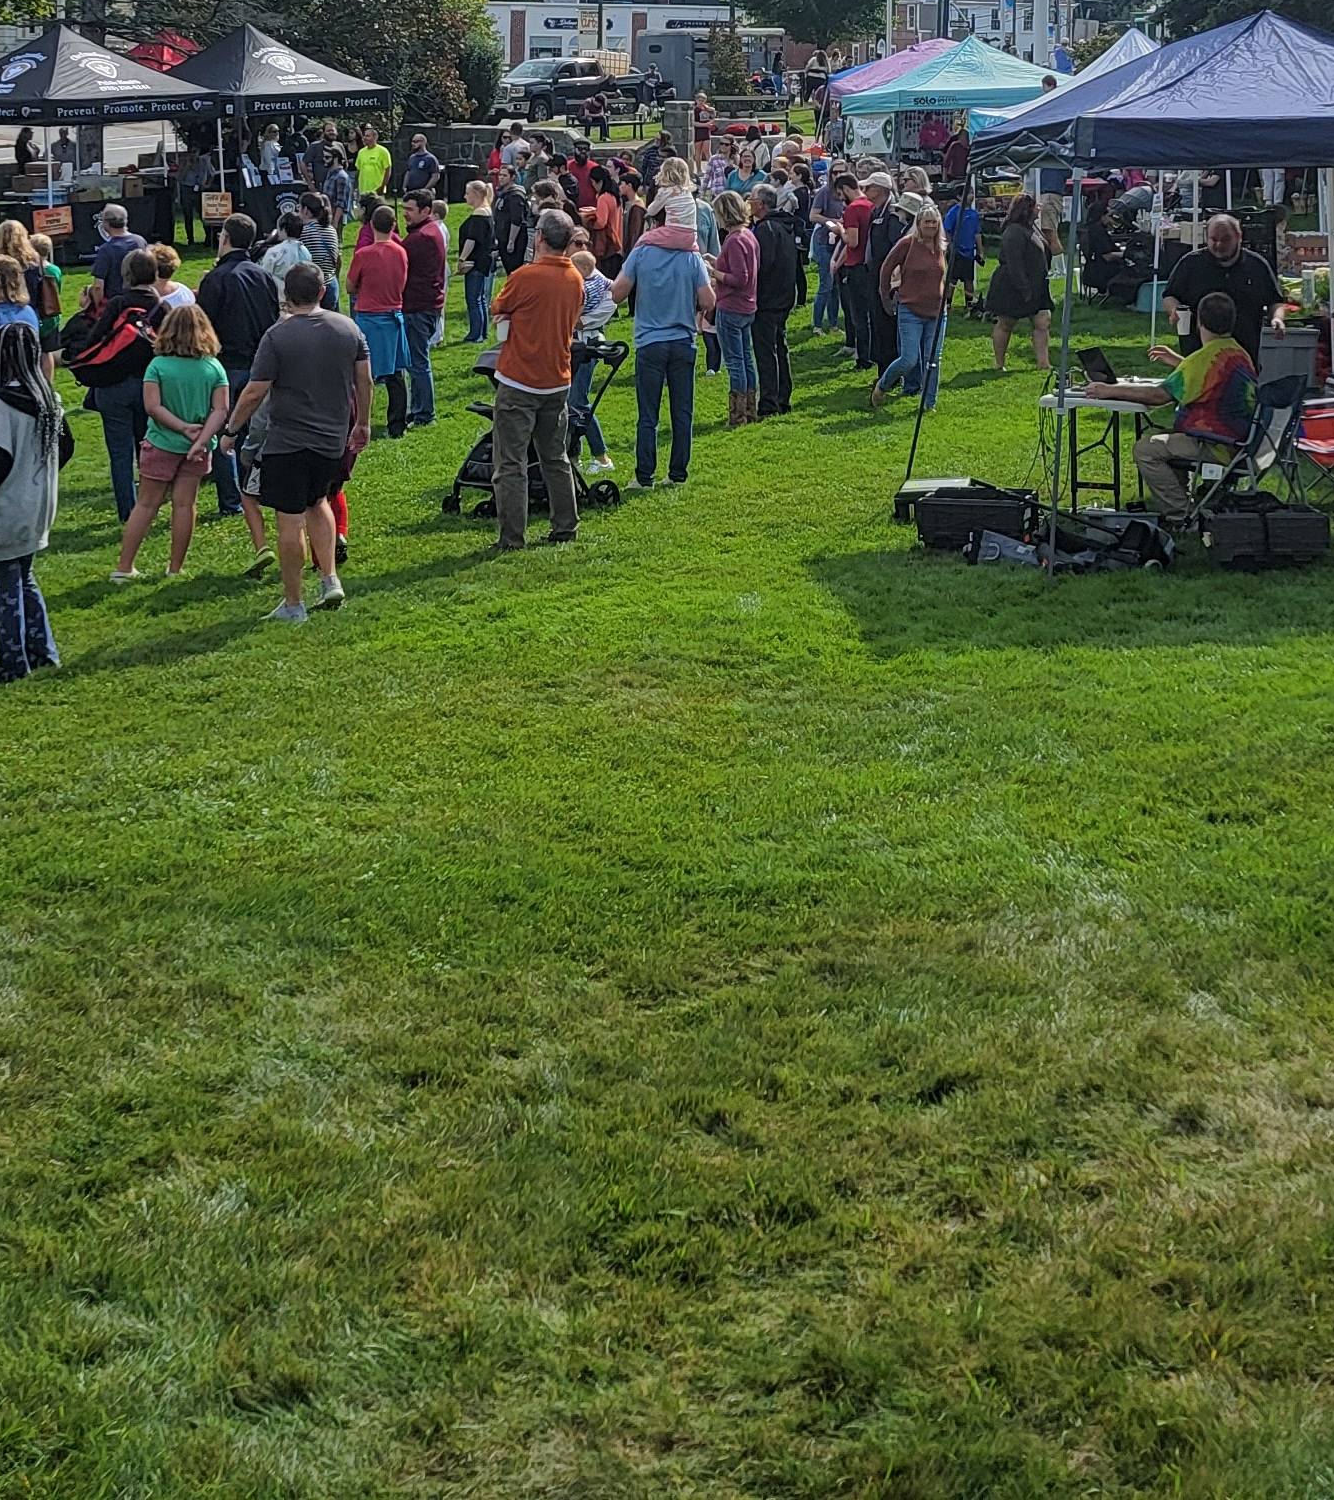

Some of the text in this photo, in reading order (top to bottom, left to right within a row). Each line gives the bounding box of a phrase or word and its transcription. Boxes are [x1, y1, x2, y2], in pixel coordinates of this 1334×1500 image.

[57, 101, 189, 117] Prevent. Promote. Protect.
[254, 97, 381, 111] Prevent. Promote. Protect.
